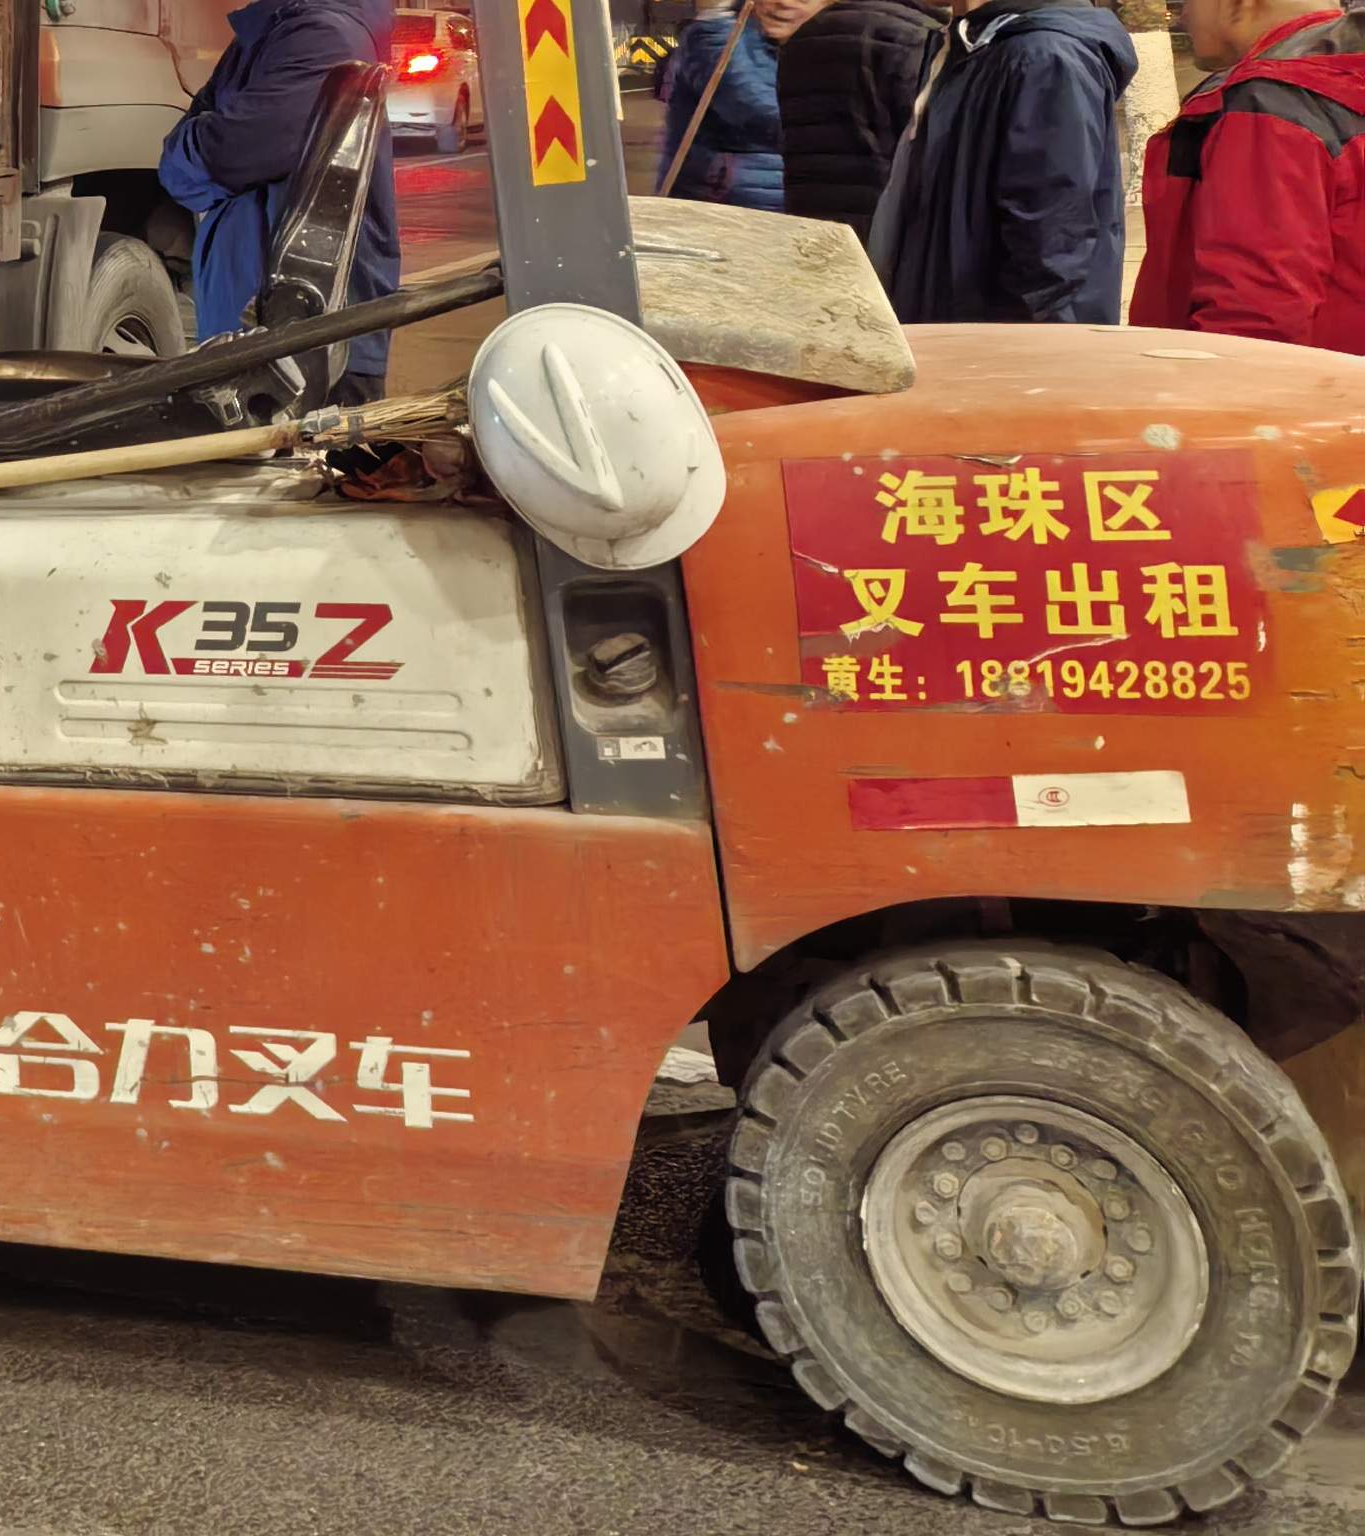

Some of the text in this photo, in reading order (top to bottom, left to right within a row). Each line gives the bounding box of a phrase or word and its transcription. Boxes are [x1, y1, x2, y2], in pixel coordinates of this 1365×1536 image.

[874, 466, 1172, 545] 海珠区
[838, 562, 1239, 639] 叉车出租
[955, 660, 1252, 701] 18819428825
